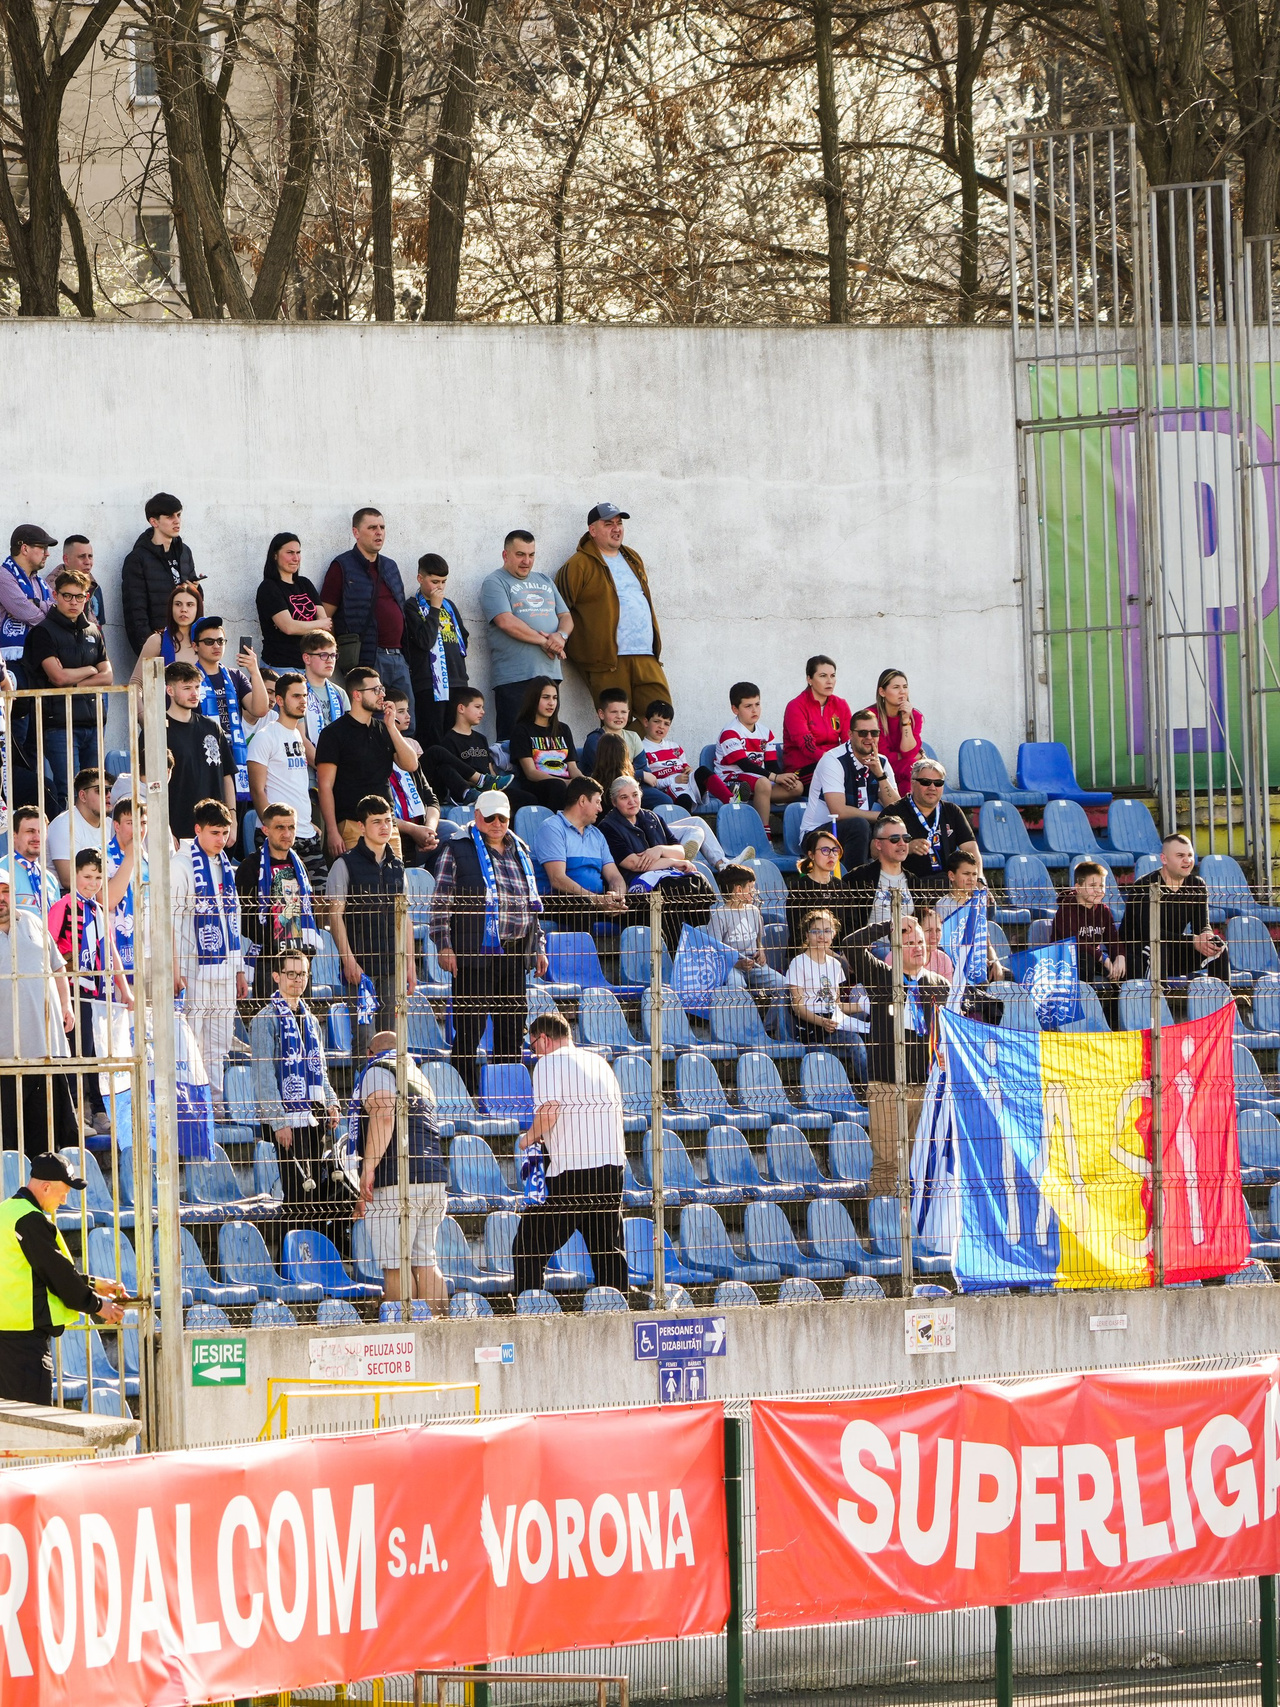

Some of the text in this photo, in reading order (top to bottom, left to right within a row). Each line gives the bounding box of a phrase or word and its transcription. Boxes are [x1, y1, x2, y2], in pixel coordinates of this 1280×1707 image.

[510, 582, 553, 594] TOM TAILOR
[530, 736, 568, 749] NIRVANA
[657, 768, 673, 776] AUTO
[659, 1324, 704, 1336] PERSOANE CU
[364, 1341, 413, 1357] PELUZA SUD
[502, 1347, 513, 1359] WC
[367, 1360, 411, 1376] SECTOR B
[387, 1523, 449, 1578] S.A.
[480, 1488, 696, 1587] VORONA
